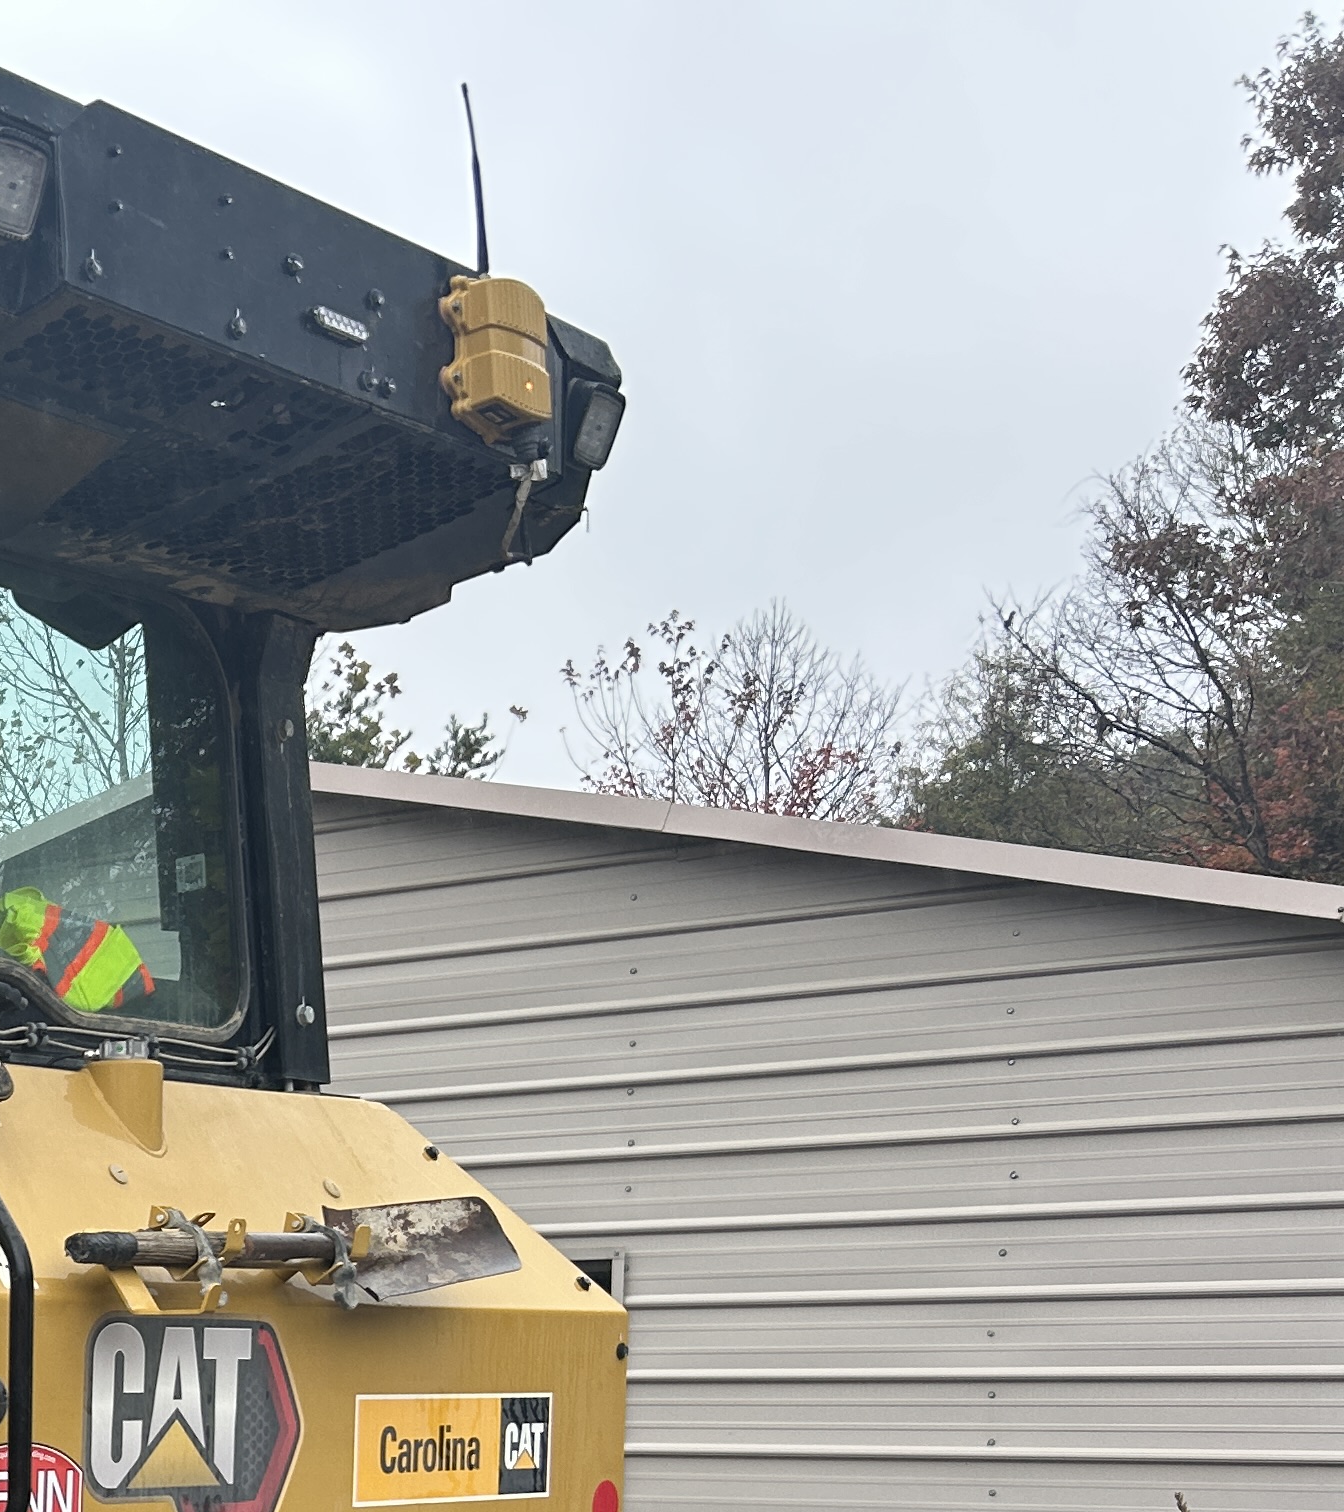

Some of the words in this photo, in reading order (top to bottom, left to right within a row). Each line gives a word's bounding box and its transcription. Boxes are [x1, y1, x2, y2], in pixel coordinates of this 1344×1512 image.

[90, 1322, 253, 1489] CAT
[380, 1424, 481, 1475] Carolina
[504, 1422, 545, 1471] CAT
